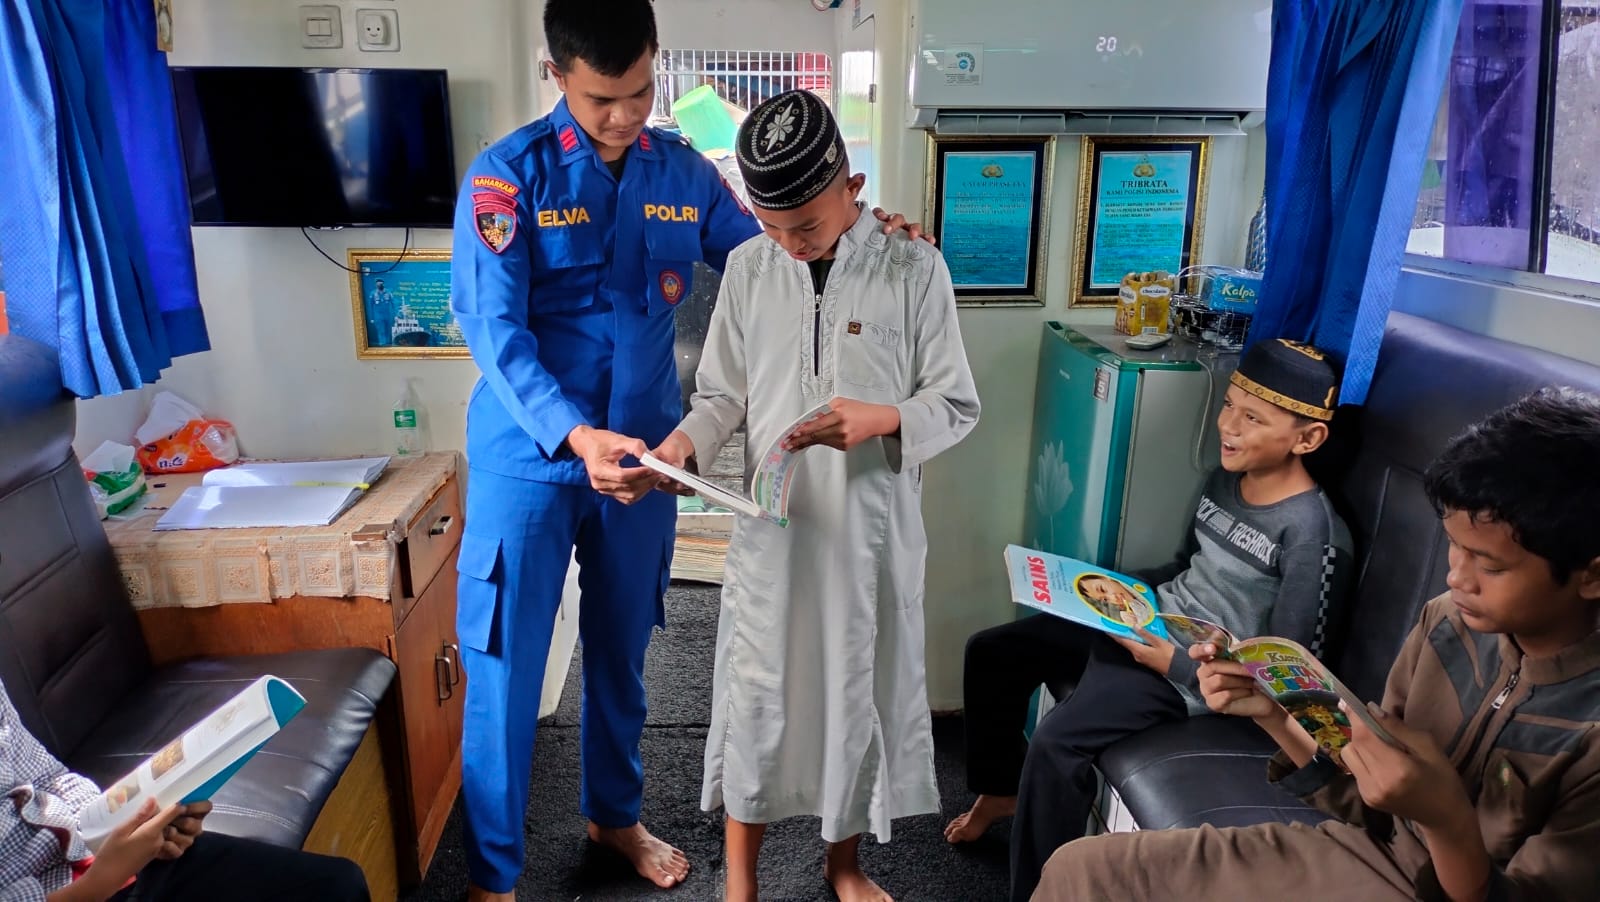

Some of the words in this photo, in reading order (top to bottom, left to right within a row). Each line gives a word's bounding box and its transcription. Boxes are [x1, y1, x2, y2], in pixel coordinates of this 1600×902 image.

[1096, 37, 1117, 52] 20
[474, 178, 516, 194] BAHARKAM
[1120, 180, 1168, 188] TRIBRATA
[538, 207, 591, 227] ELVA
[644, 204, 699, 223] POLRI
[1221, 282, 1256, 299] Kalpa
[1196, 494, 1221, 522] OCK
[1026, 554, 1052, 605] SAINS
